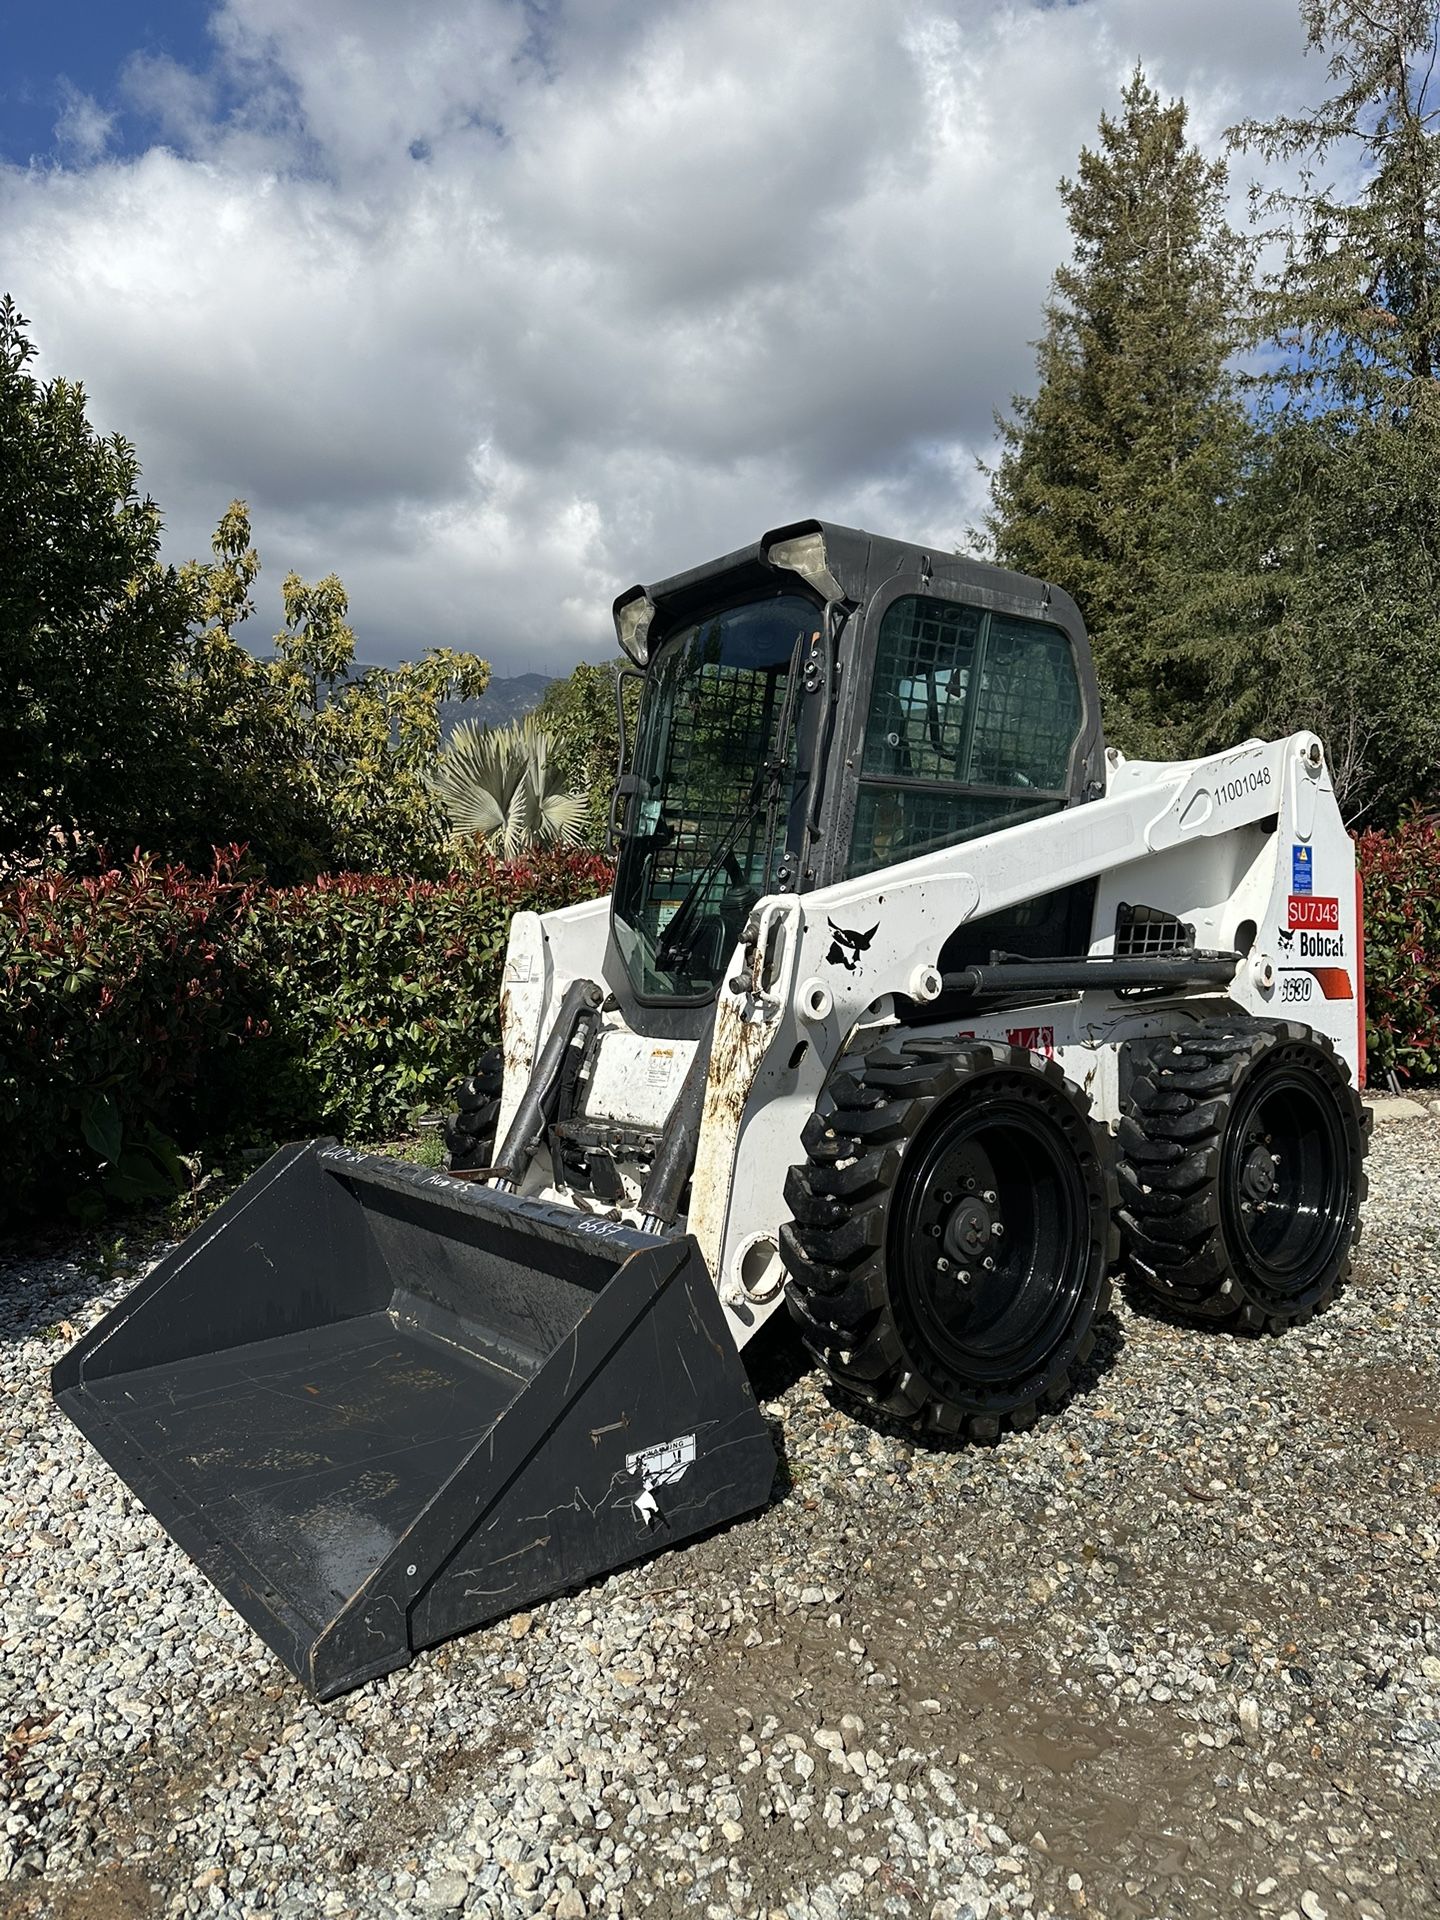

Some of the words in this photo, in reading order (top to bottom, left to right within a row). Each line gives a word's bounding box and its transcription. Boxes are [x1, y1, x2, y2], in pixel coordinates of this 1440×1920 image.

[1214, 766, 1271, 806] 11001048
[1288, 902, 1338, 923] SU7J43
[1300, 932, 1344, 957] Bobcat
[452, 1180, 476, 1193] 25
[577, 1218, 624, 1237] 6687
